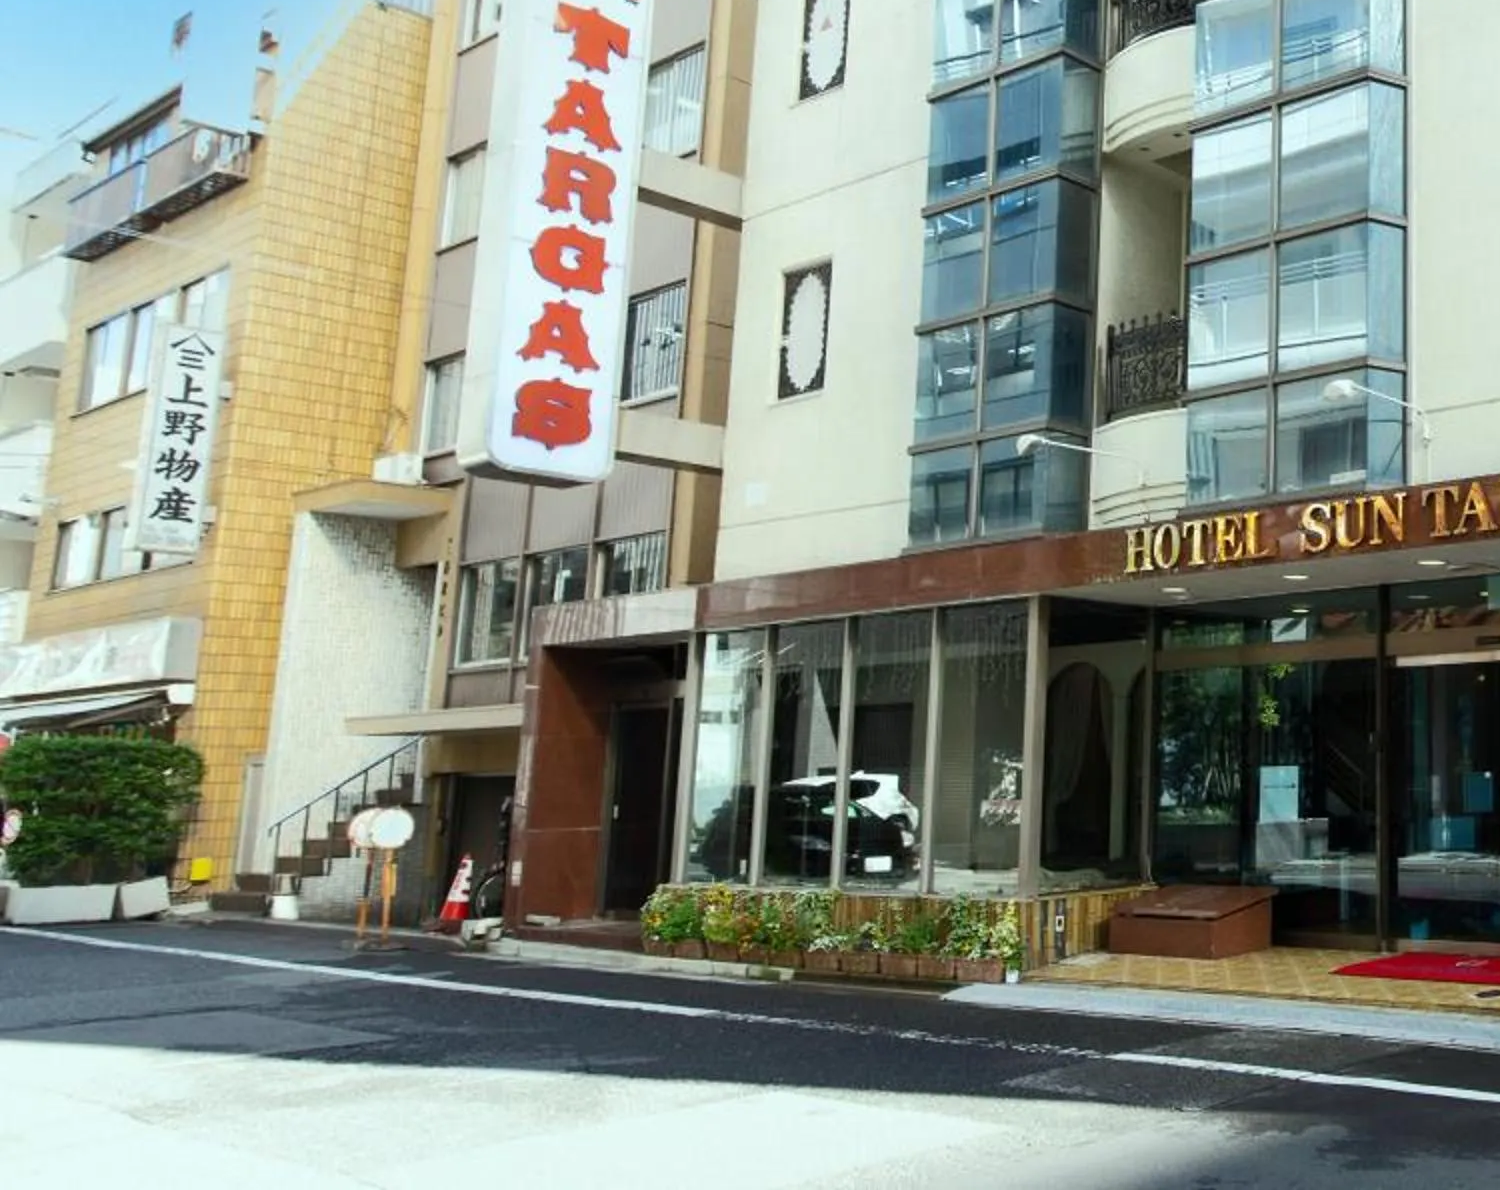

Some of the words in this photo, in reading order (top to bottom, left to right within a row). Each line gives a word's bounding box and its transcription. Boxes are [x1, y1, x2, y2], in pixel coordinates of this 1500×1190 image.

[511, 1, 631, 451] TARGAS
[1123, 510, 1270, 575] HOTEL
[1300, 491, 1408, 555] SUN
